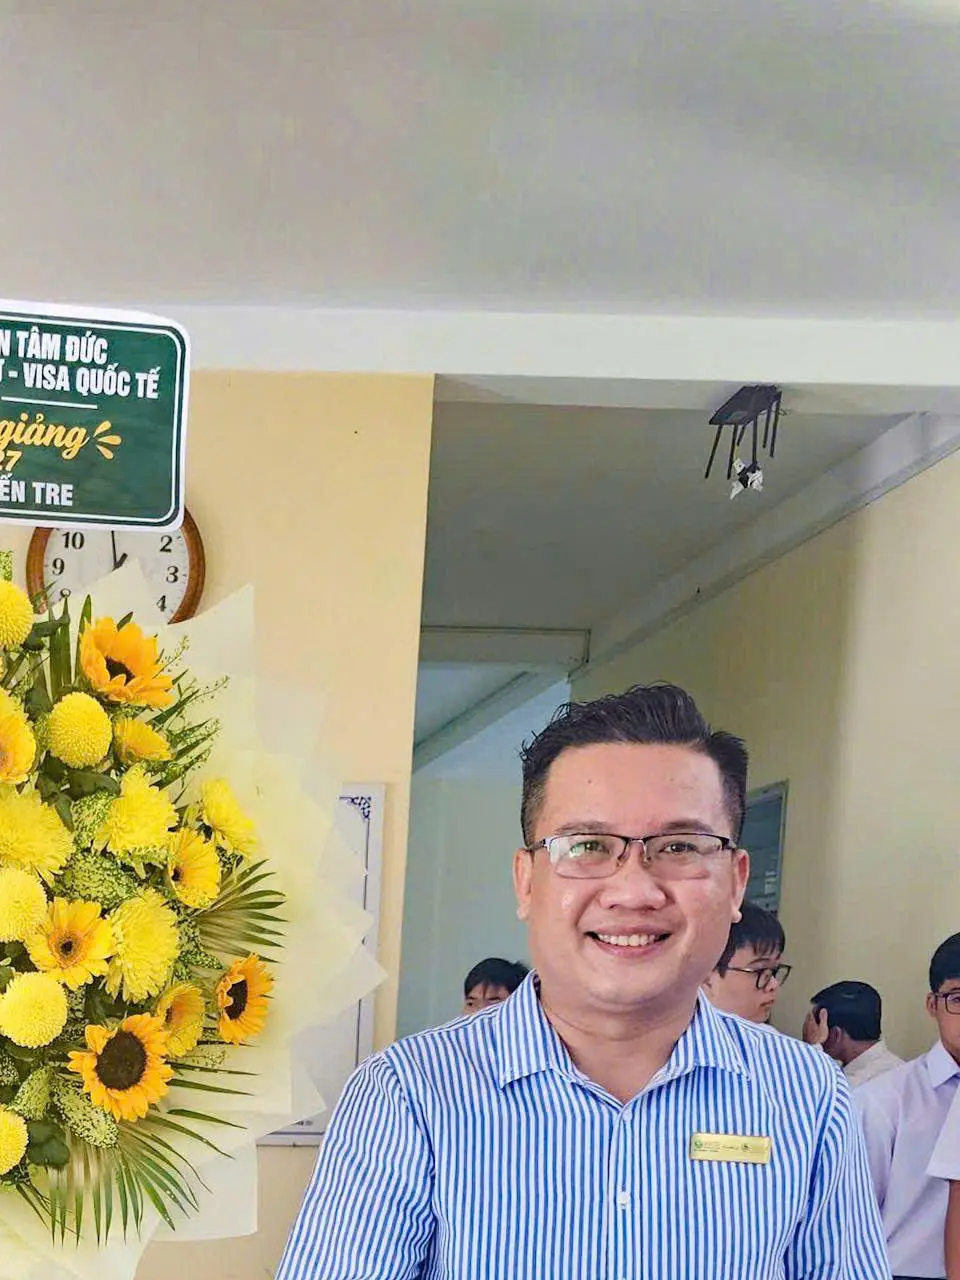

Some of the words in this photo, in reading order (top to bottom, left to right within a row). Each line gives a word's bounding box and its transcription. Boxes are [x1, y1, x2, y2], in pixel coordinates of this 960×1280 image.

[16, 327, 60, 361] TÂM
[65, 331, 108, 364] ĐỨC
[23, 362, 71, 391] VISA
[76, 362, 131, 396] QUỐC
[135, 366, 161, 398] TẾ
[32, 482, 73, 506] TRE
[62, 532, 85, 550] 10
[160, 535, 173, 552] 2
[52, 558, 65, 575] 9
[166, 566, 178, 583] 3
[156, 595, 167, 612] 4
